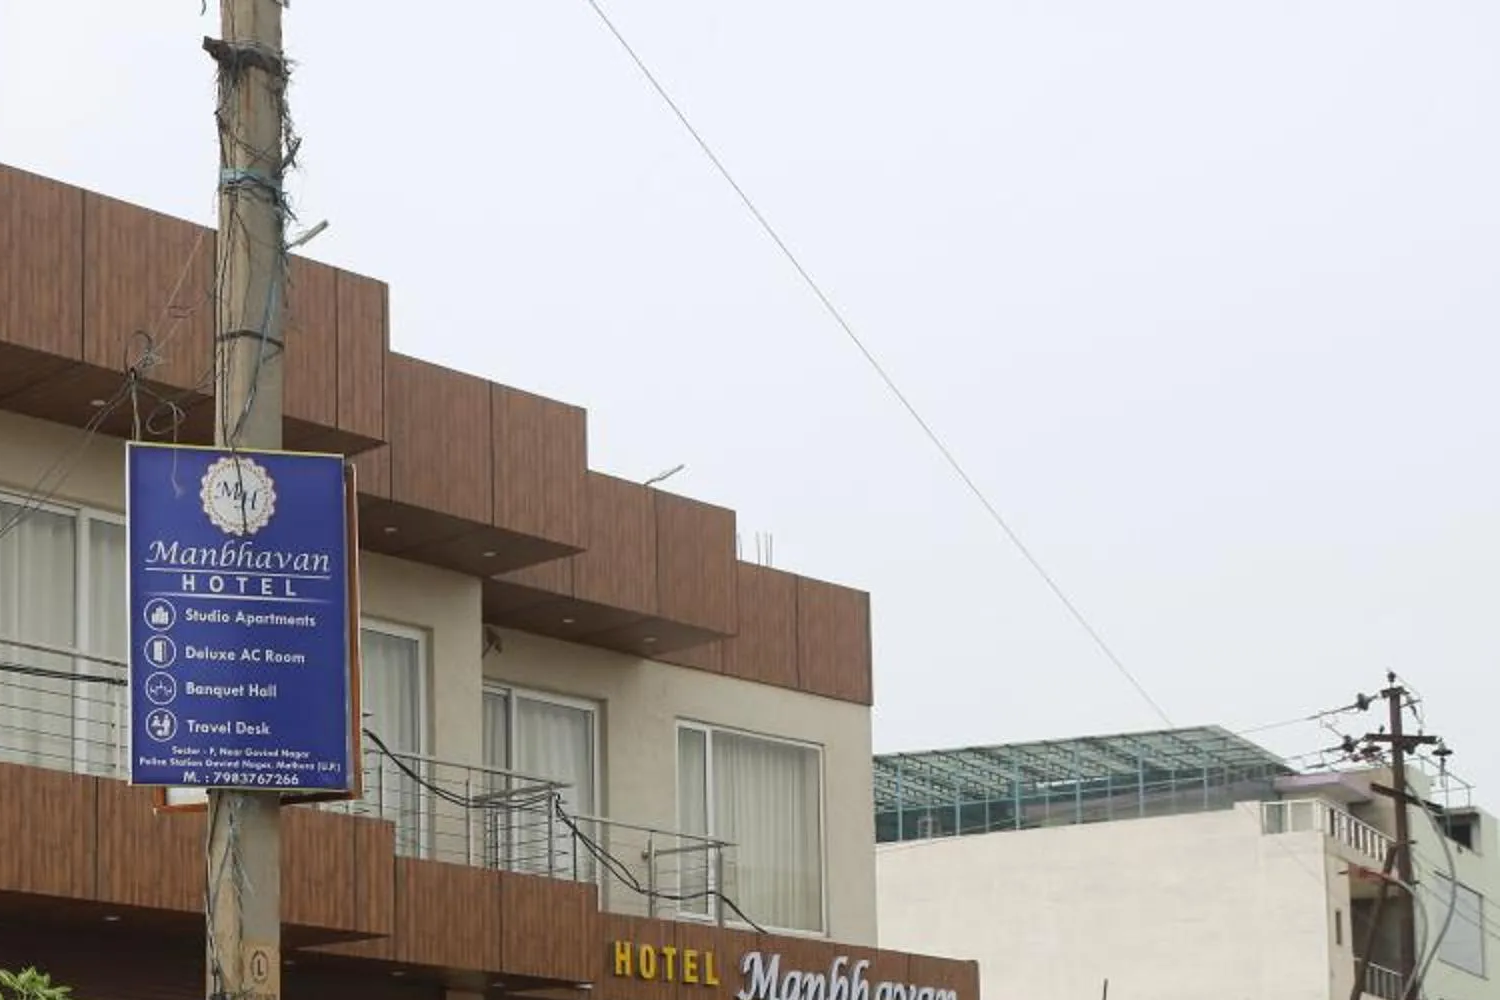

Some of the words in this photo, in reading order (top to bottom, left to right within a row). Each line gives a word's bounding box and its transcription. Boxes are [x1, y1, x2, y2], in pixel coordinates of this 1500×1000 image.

[146, 540, 330, 573] Manbhavan
[182, 573, 296, 596] HOTEL
[185, 611, 229, 623] Studio
[236, 612, 317, 628] Apartments
[185, 646, 235, 661] Deluxe
[240, 650, 261, 661] AC
[265, 650, 305, 664] Room
[185, 682, 244, 697] Banquet
[249, 685, 277, 698] Hall
[187, 720, 231, 734] Travel
[236, 722, 270, 735] Desk
[213, 772, 299, 785] 7983767266
[614, 940, 720, 986] HOTEL
